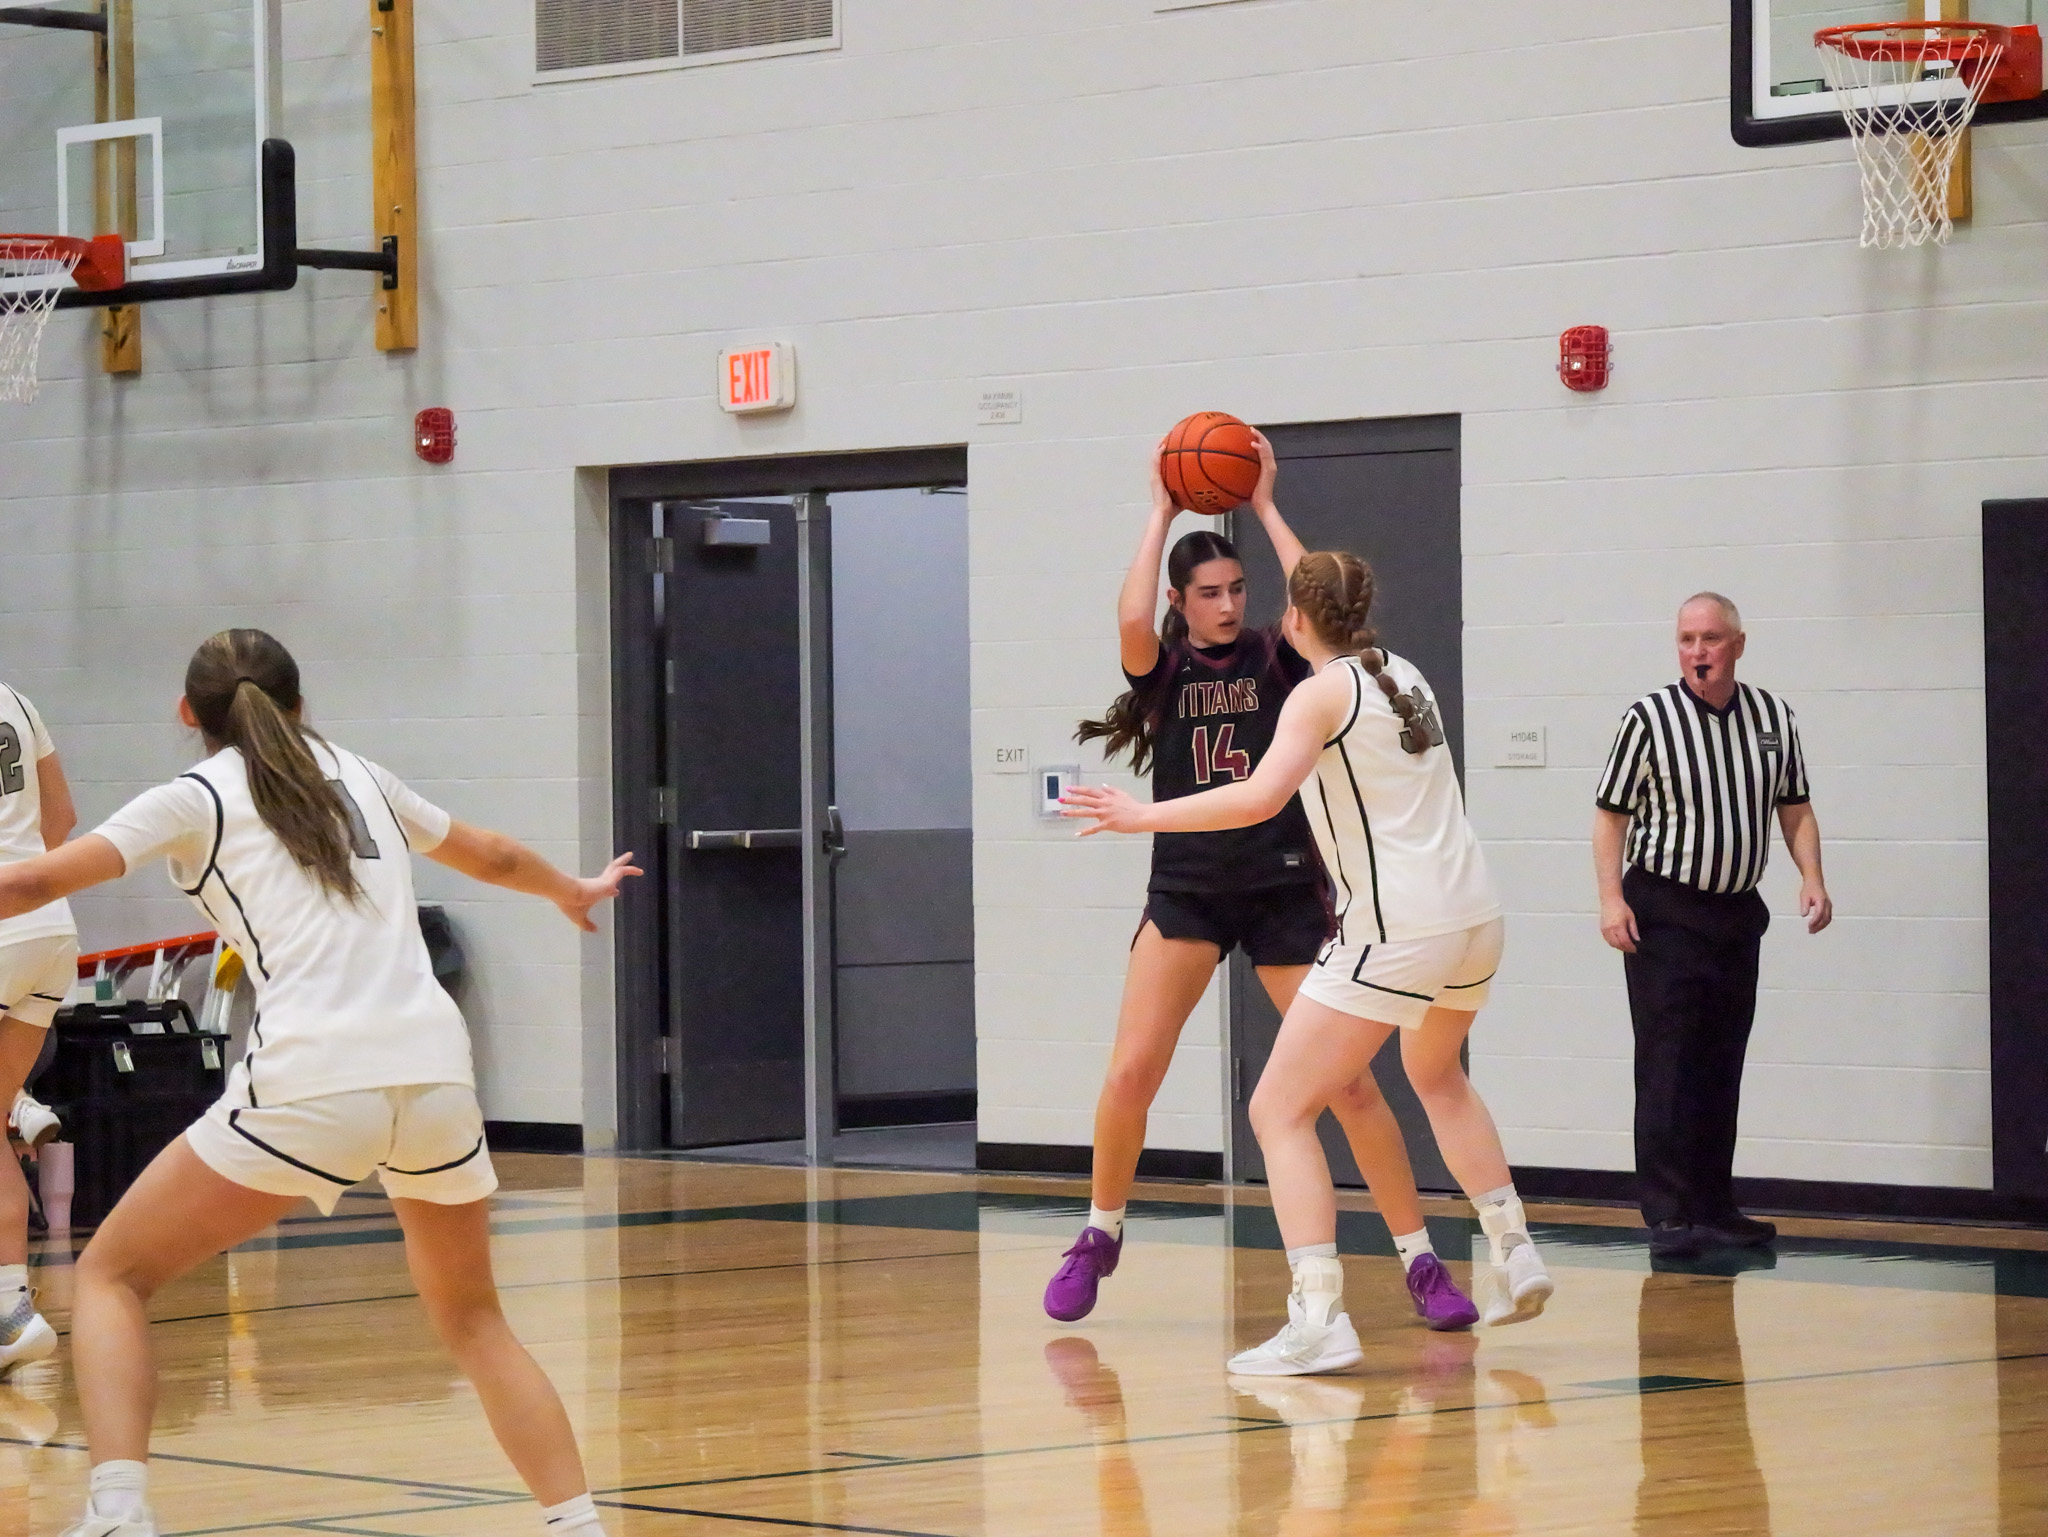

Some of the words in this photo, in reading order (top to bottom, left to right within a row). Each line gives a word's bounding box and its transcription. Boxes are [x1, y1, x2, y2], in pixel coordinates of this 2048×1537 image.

[728, 349, 771, 405] EXIT
[0, 721, 25, 798] 2
[996, 748, 1025, 762] EXIT
[1191, 722, 1251, 785] 14
[1511, 731, 1538, 742] H104B
